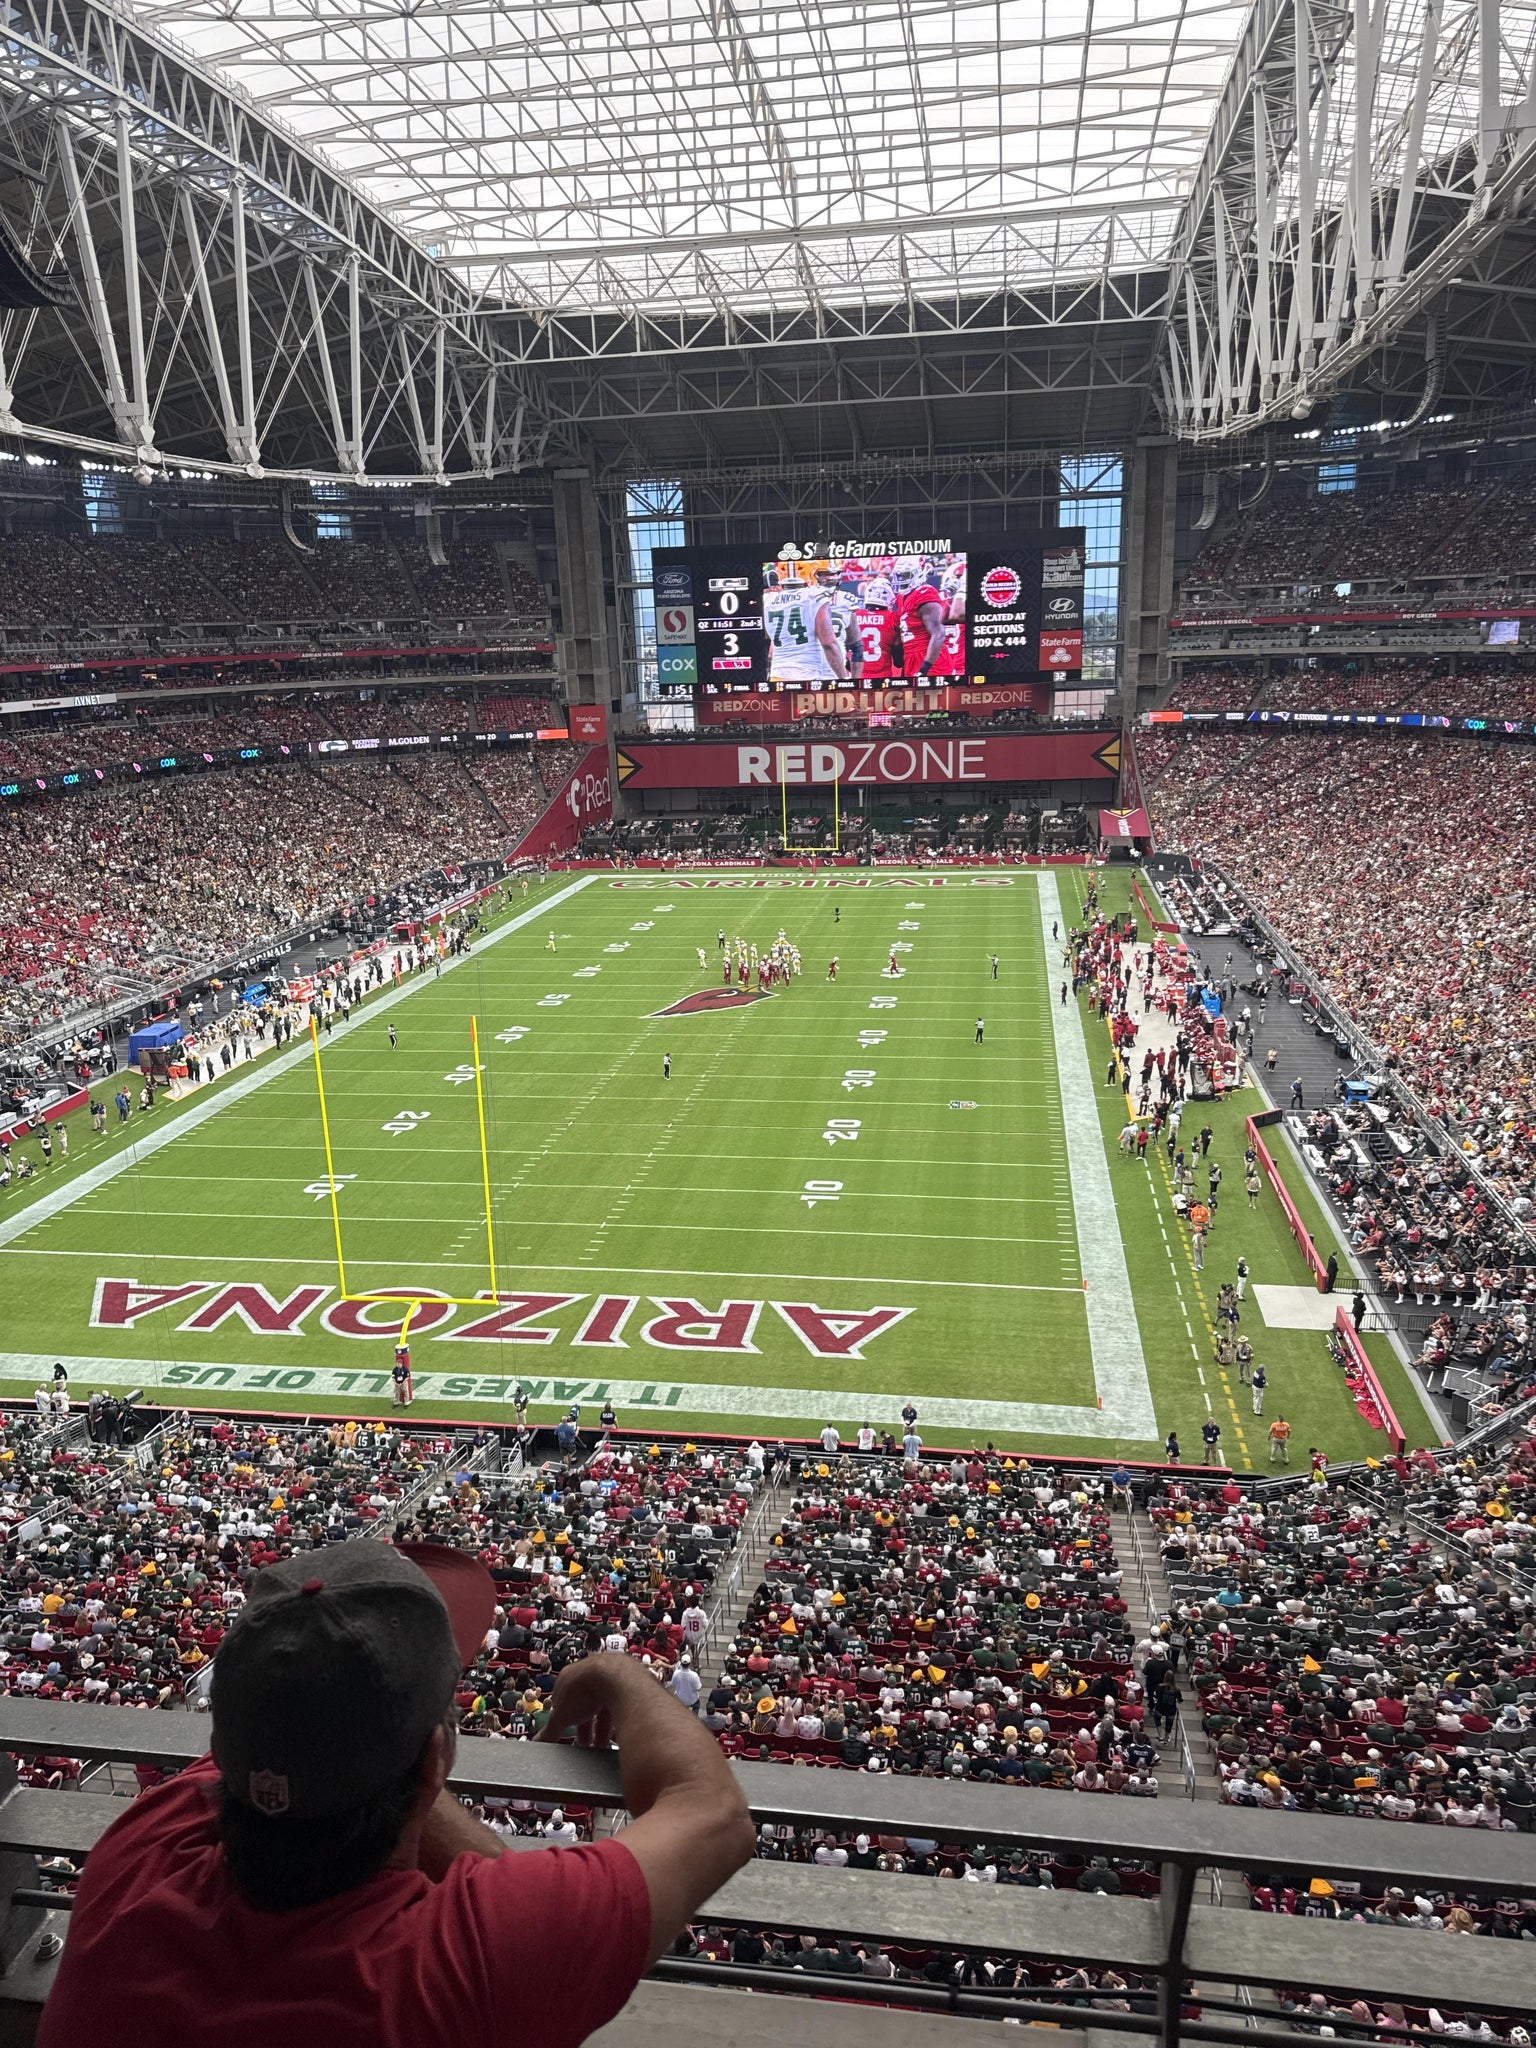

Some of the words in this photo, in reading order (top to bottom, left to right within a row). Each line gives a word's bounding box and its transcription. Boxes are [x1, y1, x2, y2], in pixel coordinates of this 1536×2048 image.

[888, 539, 951, 555] STADIUM
[662, 574, 683, 584] Ford
[720, 592, 739, 615] 0
[771, 592, 801, 605] JENKINS
[856, 615, 884, 625] BAKER
[974, 613, 1014, 622] LOCATED
[1014, 612, 1027, 621] AT
[1045, 612, 1079, 620] HYUNDAI
[713, 620, 733, 628] 11:51
[767, 607, 809, 647] 74
[973, 624, 1025, 635] SECTIONS
[723, 633, 739, 656] 3
[861, 628, 882, 662] 3
[974, 638, 992, 648] 109
[993, 637, 1004, 647] &
[1005, 636, 1027, 646] 444
[661, 658, 695, 671] COX
[1054, 671, 1066, 681] 32
[668, 684, 693, 695] 11:51
[73, 695, 101, 706] AVNET
[797, 692, 856, 714] BUD
[858, 689, 943, 712] LIGHT
[960, 690, 1033, 705] REDZONE
[713, 699, 781, 712] REDZONE
[1467, 720, 1486, 730] COX
[388, 736, 430, 746] M.GOLDEN
[240, 749, 259, 759] COX
[160, 757, 176, 768] COX
[737, 740, 986, 784] REDZONE
[63, 773, 80, 785] COX
[0, 783, 19, 796] COX
[585, 767, 611, 812] Red
[608, 877, 1015, 889] CARDINALS
[572, 965, 603, 977] 40
[536, 993, 572, 1006] 50
[868, 995, 898, 1009] 50
[493, 1025, 532, 1041] 40
[857, 1029, 888, 1044] 40
[443, 1064, 487, 1082] 30
[841, 1069, 877, 1088] 30
[381, 1110, 432, 1131] 20
[822, 1118, 862, 1141] 20
[303, 1173, 359, 1194] 10
[800, 1180, 844, 1201] 10
[88, 1276, 918, 1360] ARIZONA
[162, 1365, 237, 1387] US
[242, 1369, 312, 1389] OF
[440, 1377, 615, 1402] TAKES
[628, 1385, 684, 1407] IT
[358, 1436, 368, 1447] 15
[600, 1486, 611, 1497] 21
[664, 1549, 676, 1561] 10
[600, 1594, 608, 1604] 11
[688, 1620, 700, 1632] 18
[610, 1641, 620, 1650] 12
[1113, 1653, 1129, 1664] 12
[512, 1723, 526, 1734] 10
